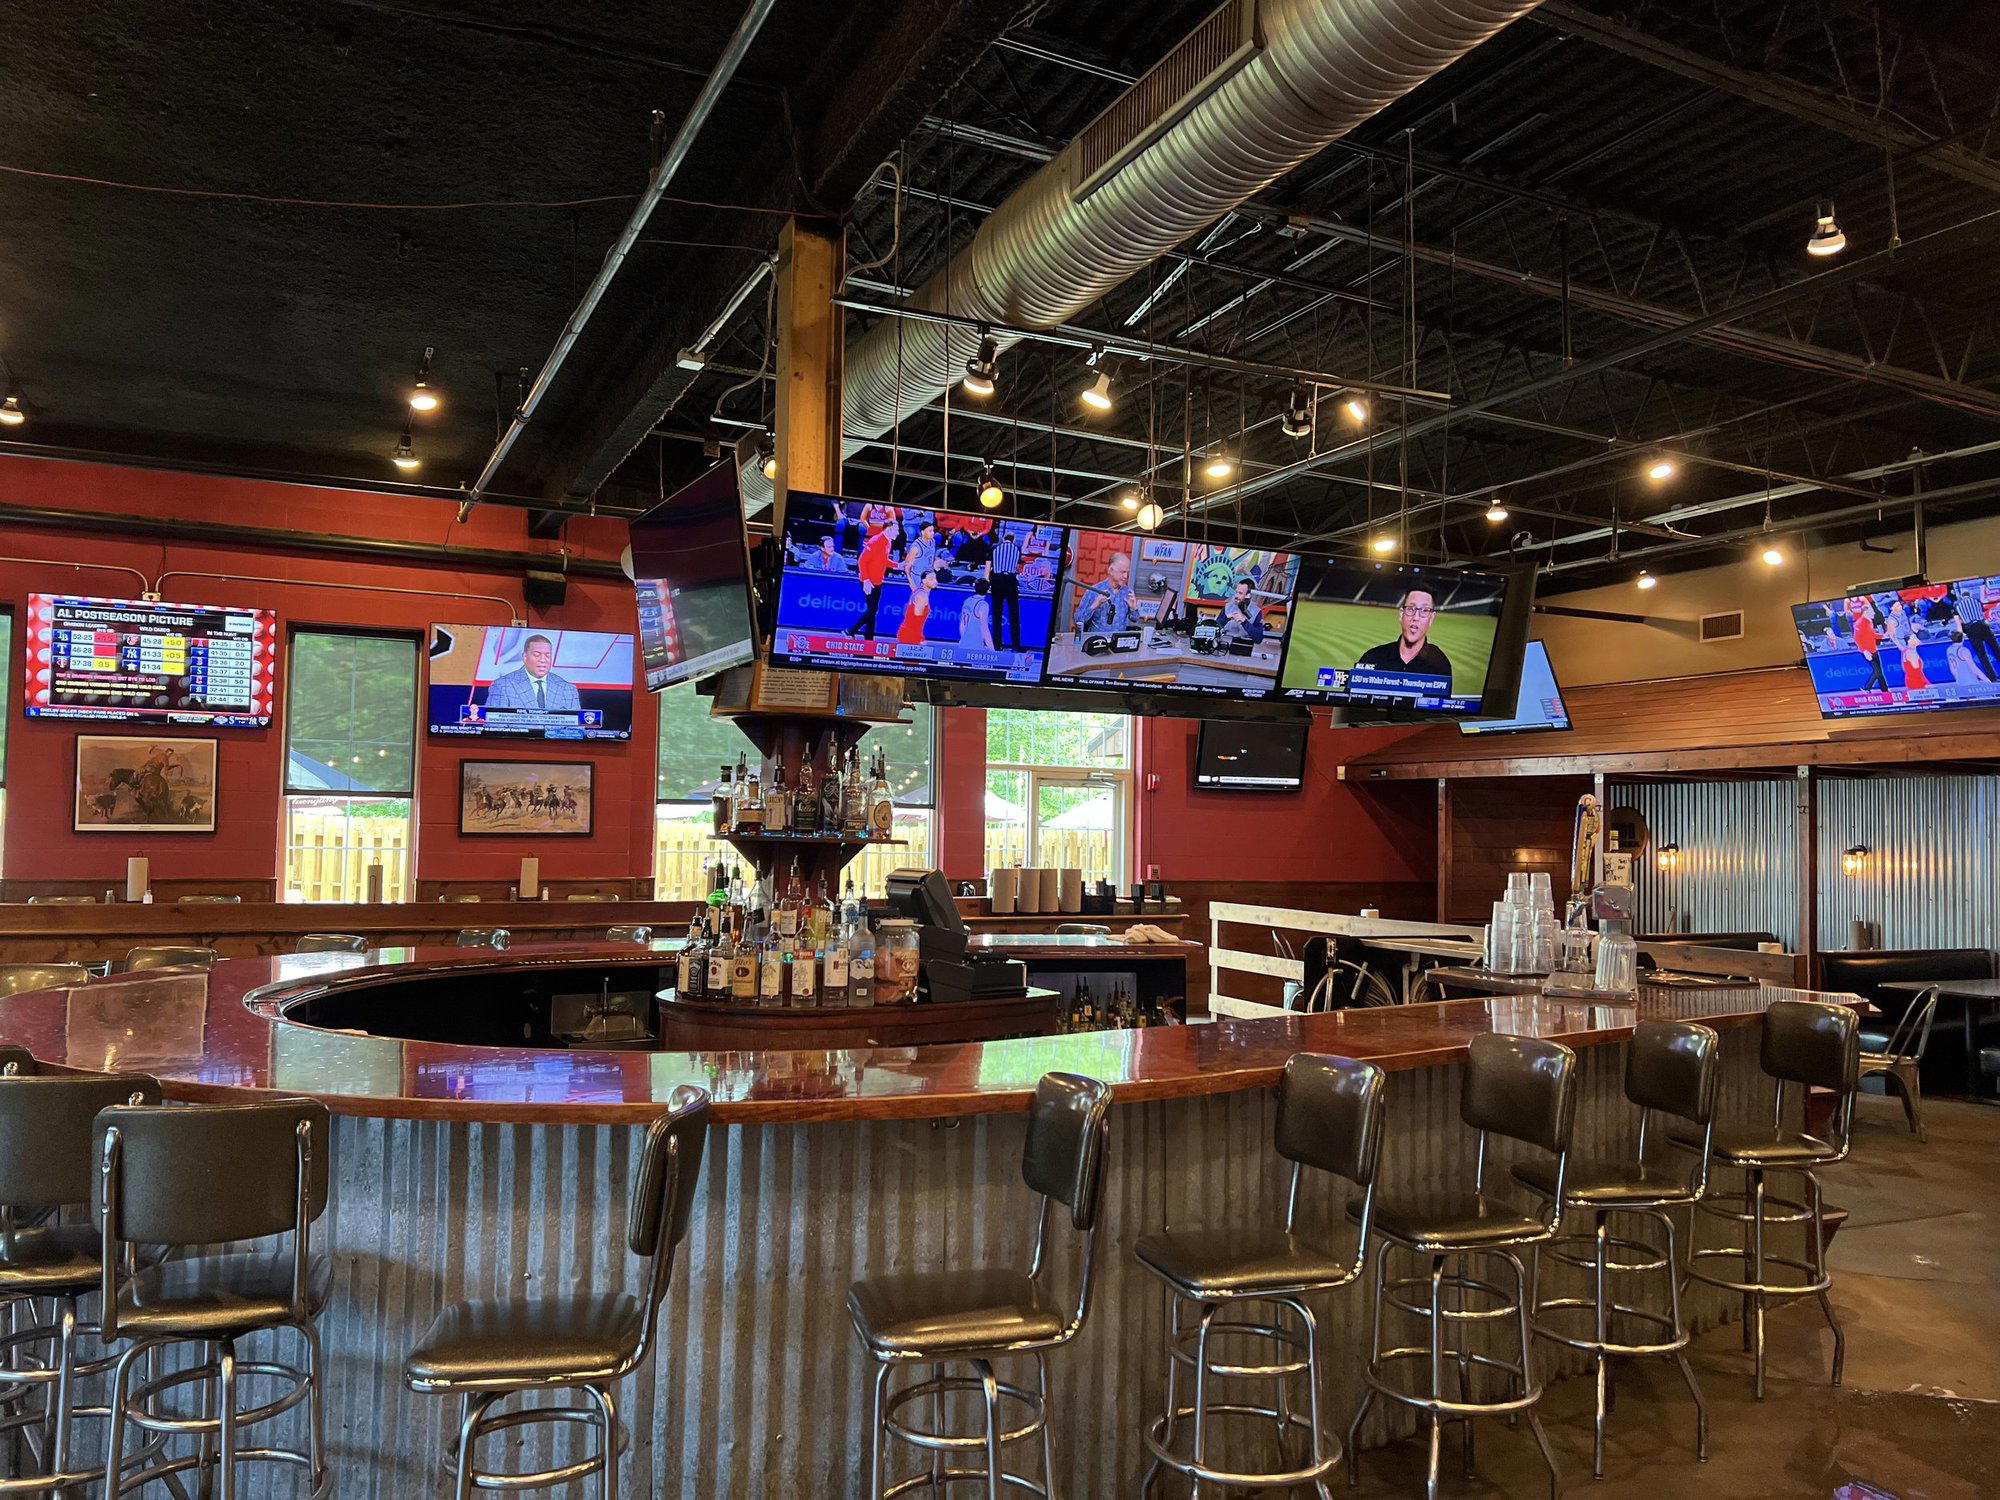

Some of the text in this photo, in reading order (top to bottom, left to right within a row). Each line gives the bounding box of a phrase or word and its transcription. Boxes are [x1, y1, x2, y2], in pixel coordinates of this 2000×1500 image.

[798, 594, 868, 612] deliciou
[57, 608, 193, 626] AL POSTSEASON PICTURE
[826, 641, 842, 650] OHIO
[844, 642, 864, 651] STATE
[876, 643, 889, 655] 60
[941, 649, 953, 659] 63
[1352, 675, 1363, 683] LSU
[1369, 676, 1383, 684] Wake
[1384, 677, 1400, 686] Forest
[1403, 678, 1426, 689] Thursday
[292, 797, 337, 806] uengling
